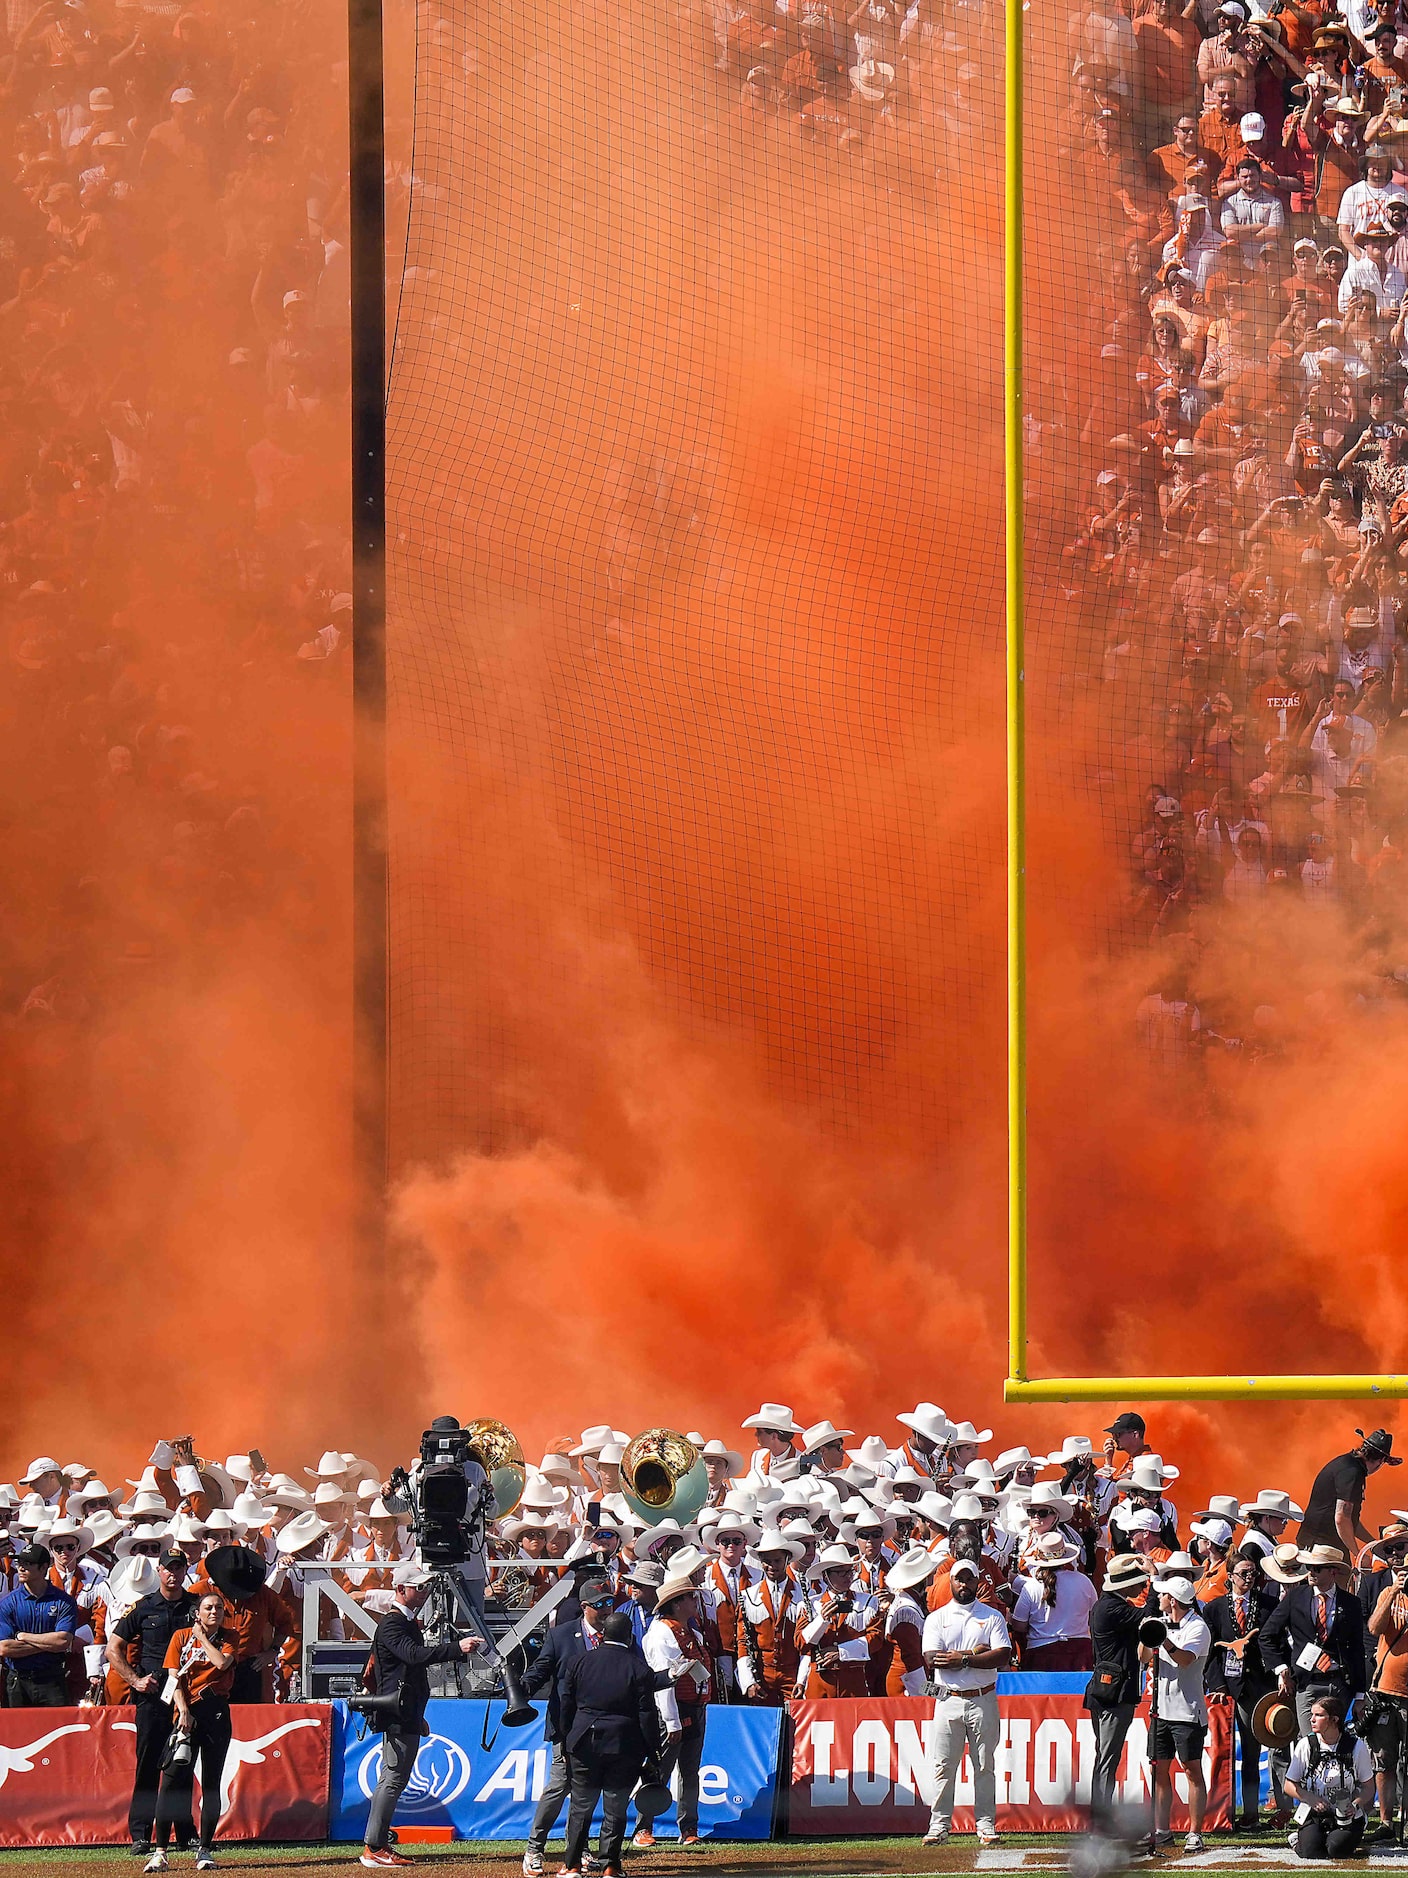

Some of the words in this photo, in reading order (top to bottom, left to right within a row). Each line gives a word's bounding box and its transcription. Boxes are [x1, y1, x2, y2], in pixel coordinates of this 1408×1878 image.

[1356, 198, 1389, 219] TEX
[1267, 697, 1300, 708] TEXAS
[810, 1718, 1211, 1808] LONHON
